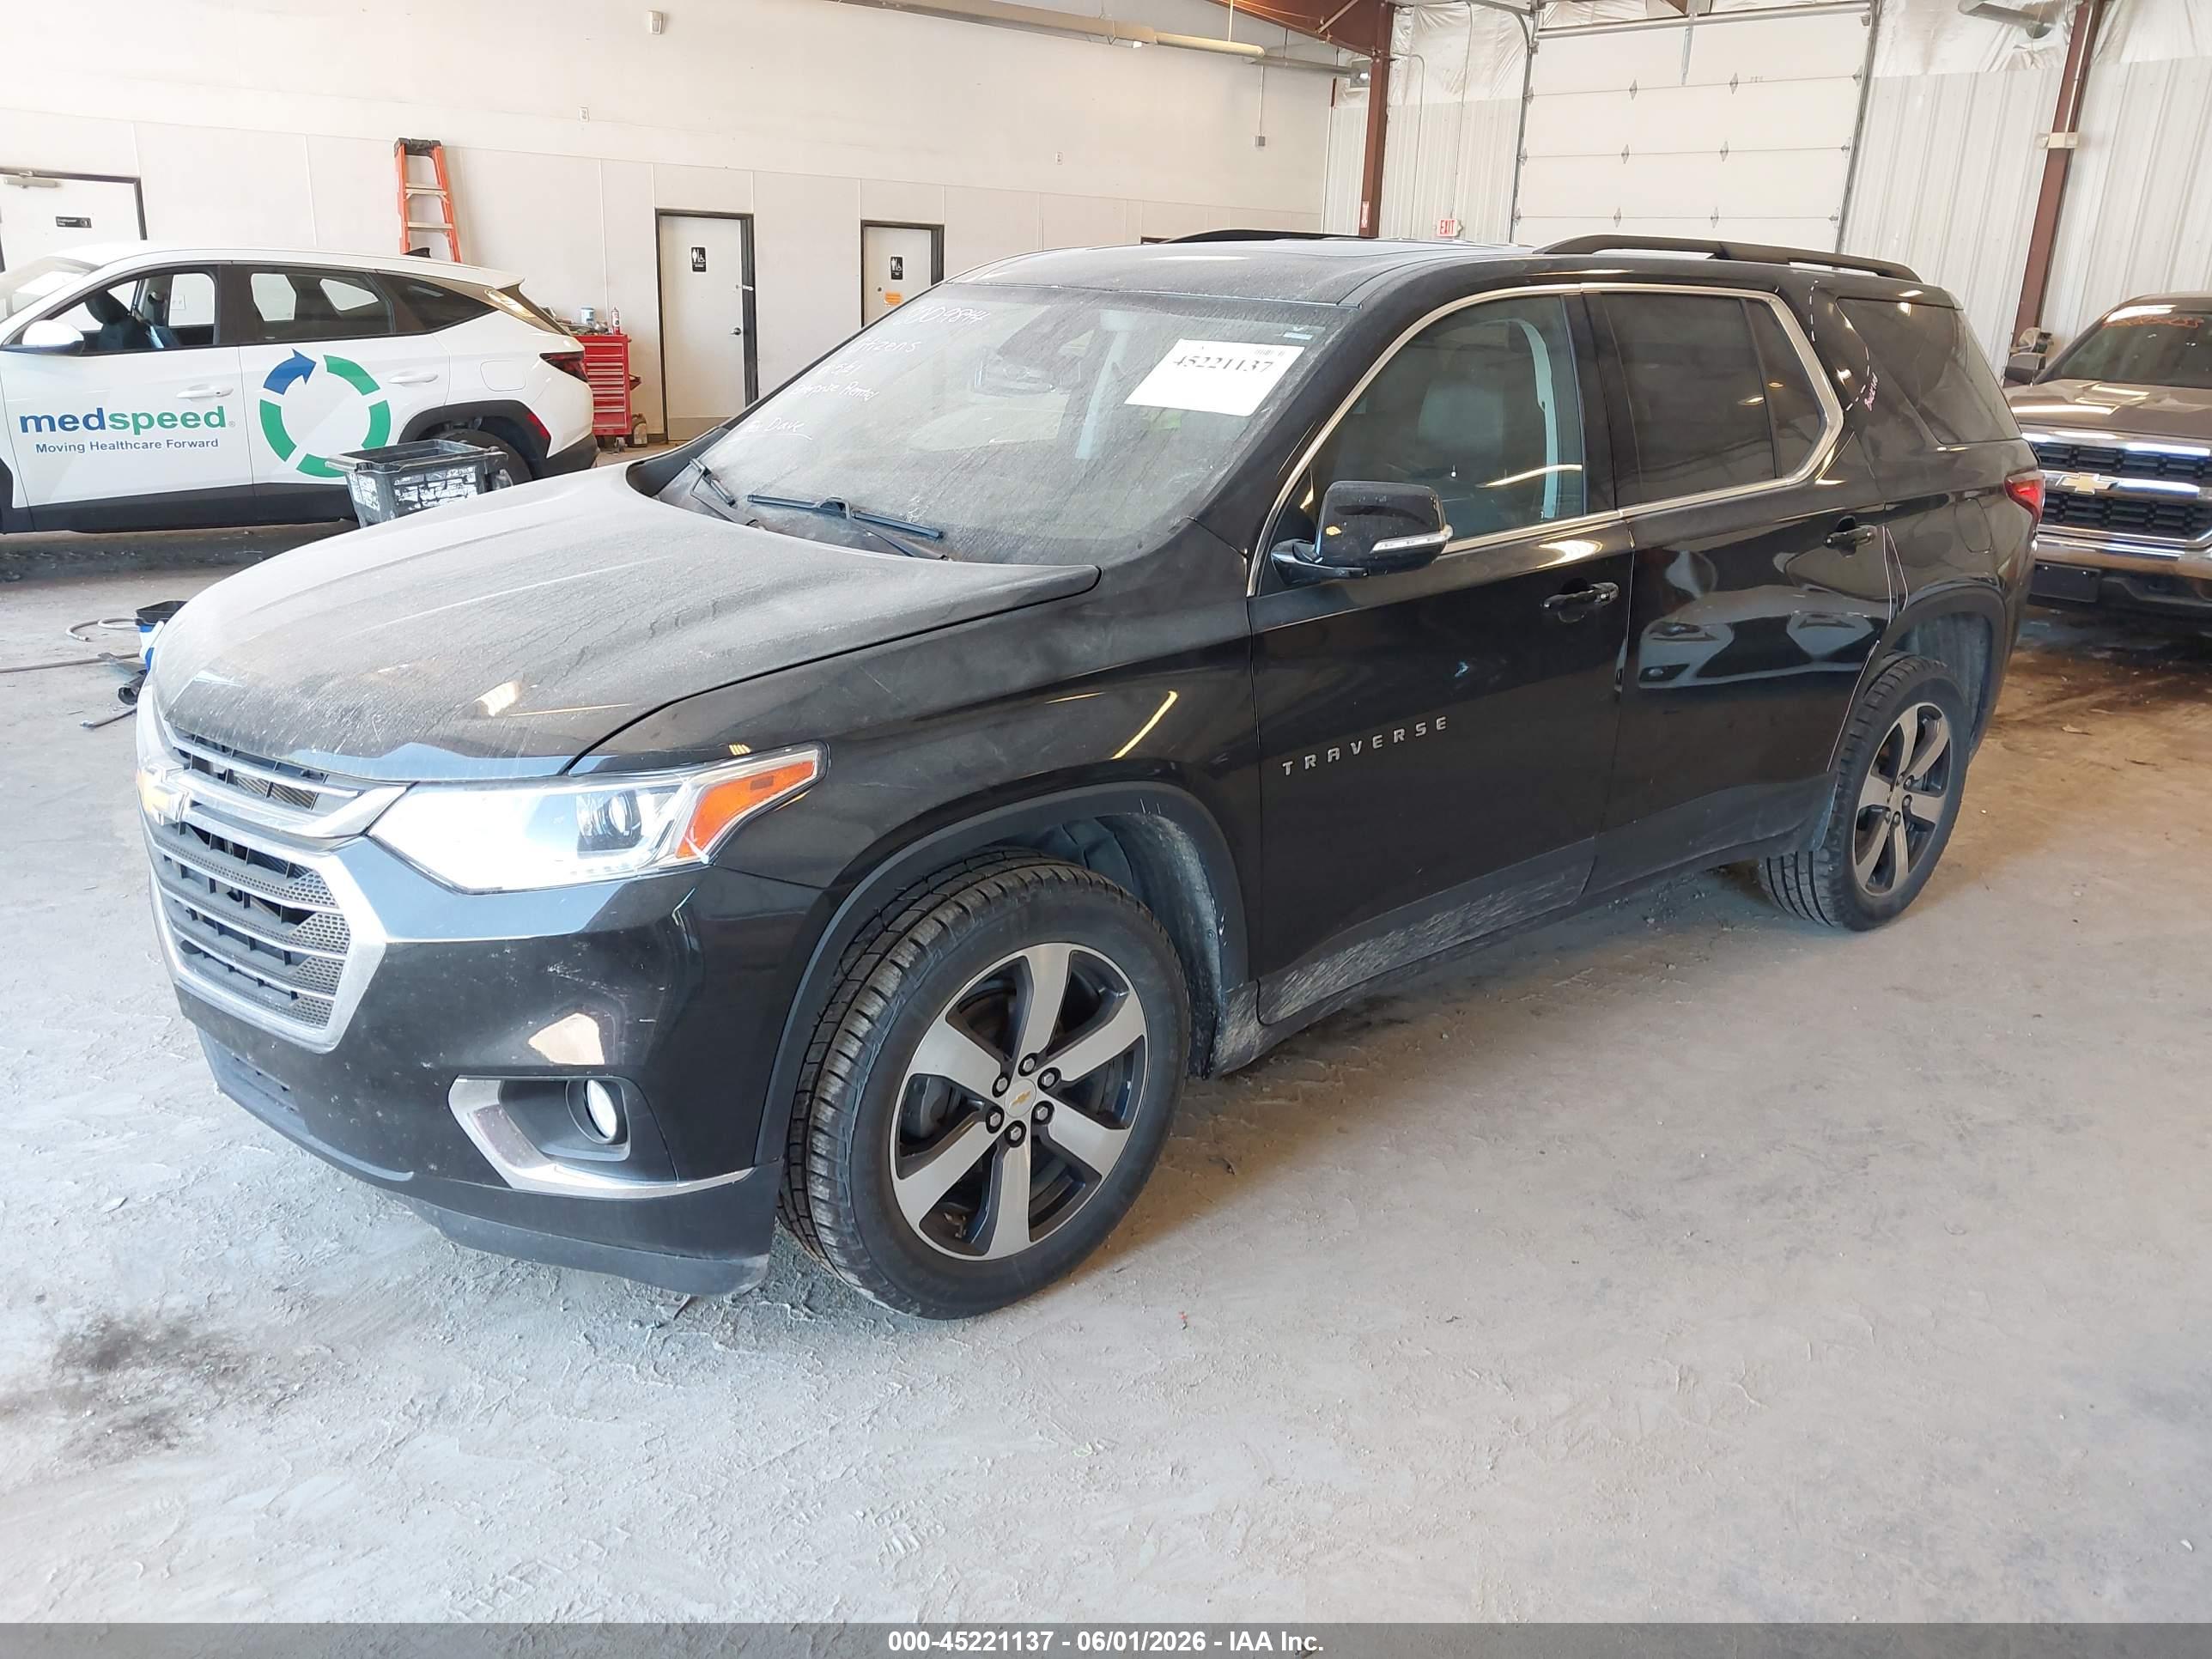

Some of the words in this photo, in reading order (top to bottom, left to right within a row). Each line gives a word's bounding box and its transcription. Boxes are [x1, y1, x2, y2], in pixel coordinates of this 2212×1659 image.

[1439, 219, 1455, 234] EXIT
[1173, 355, 1275, 373] 45221137
[19, 405, 227, 435] medspeed
[35, 442, 86, 454] Moving
[89, 441, 162, 452] Healthcare
[166, 439, 219, 448] Forward
[1282, 716, 1447, 776] TRAVERSE
